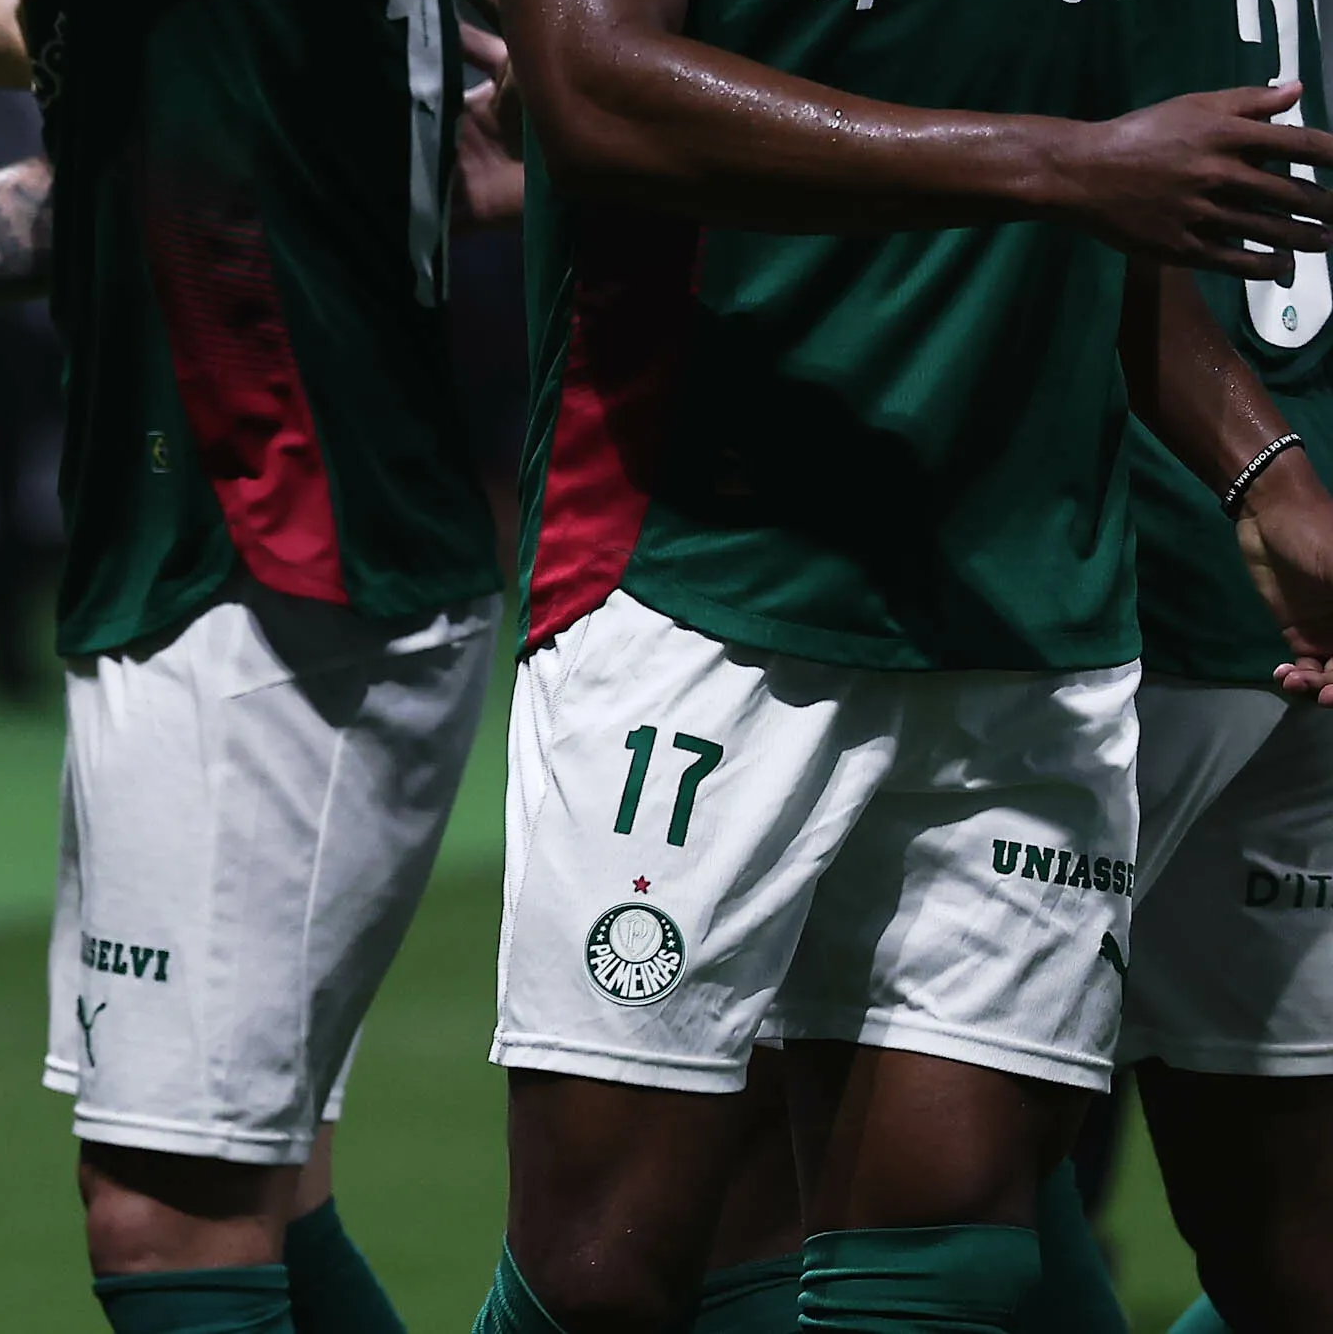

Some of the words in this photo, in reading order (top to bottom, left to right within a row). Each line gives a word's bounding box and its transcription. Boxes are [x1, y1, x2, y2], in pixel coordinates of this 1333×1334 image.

[613, 724, 724, 847] 17
[1245, 869, 1333, 908] D'IT
[589, 944, 681, 998] PALMEIRAS
